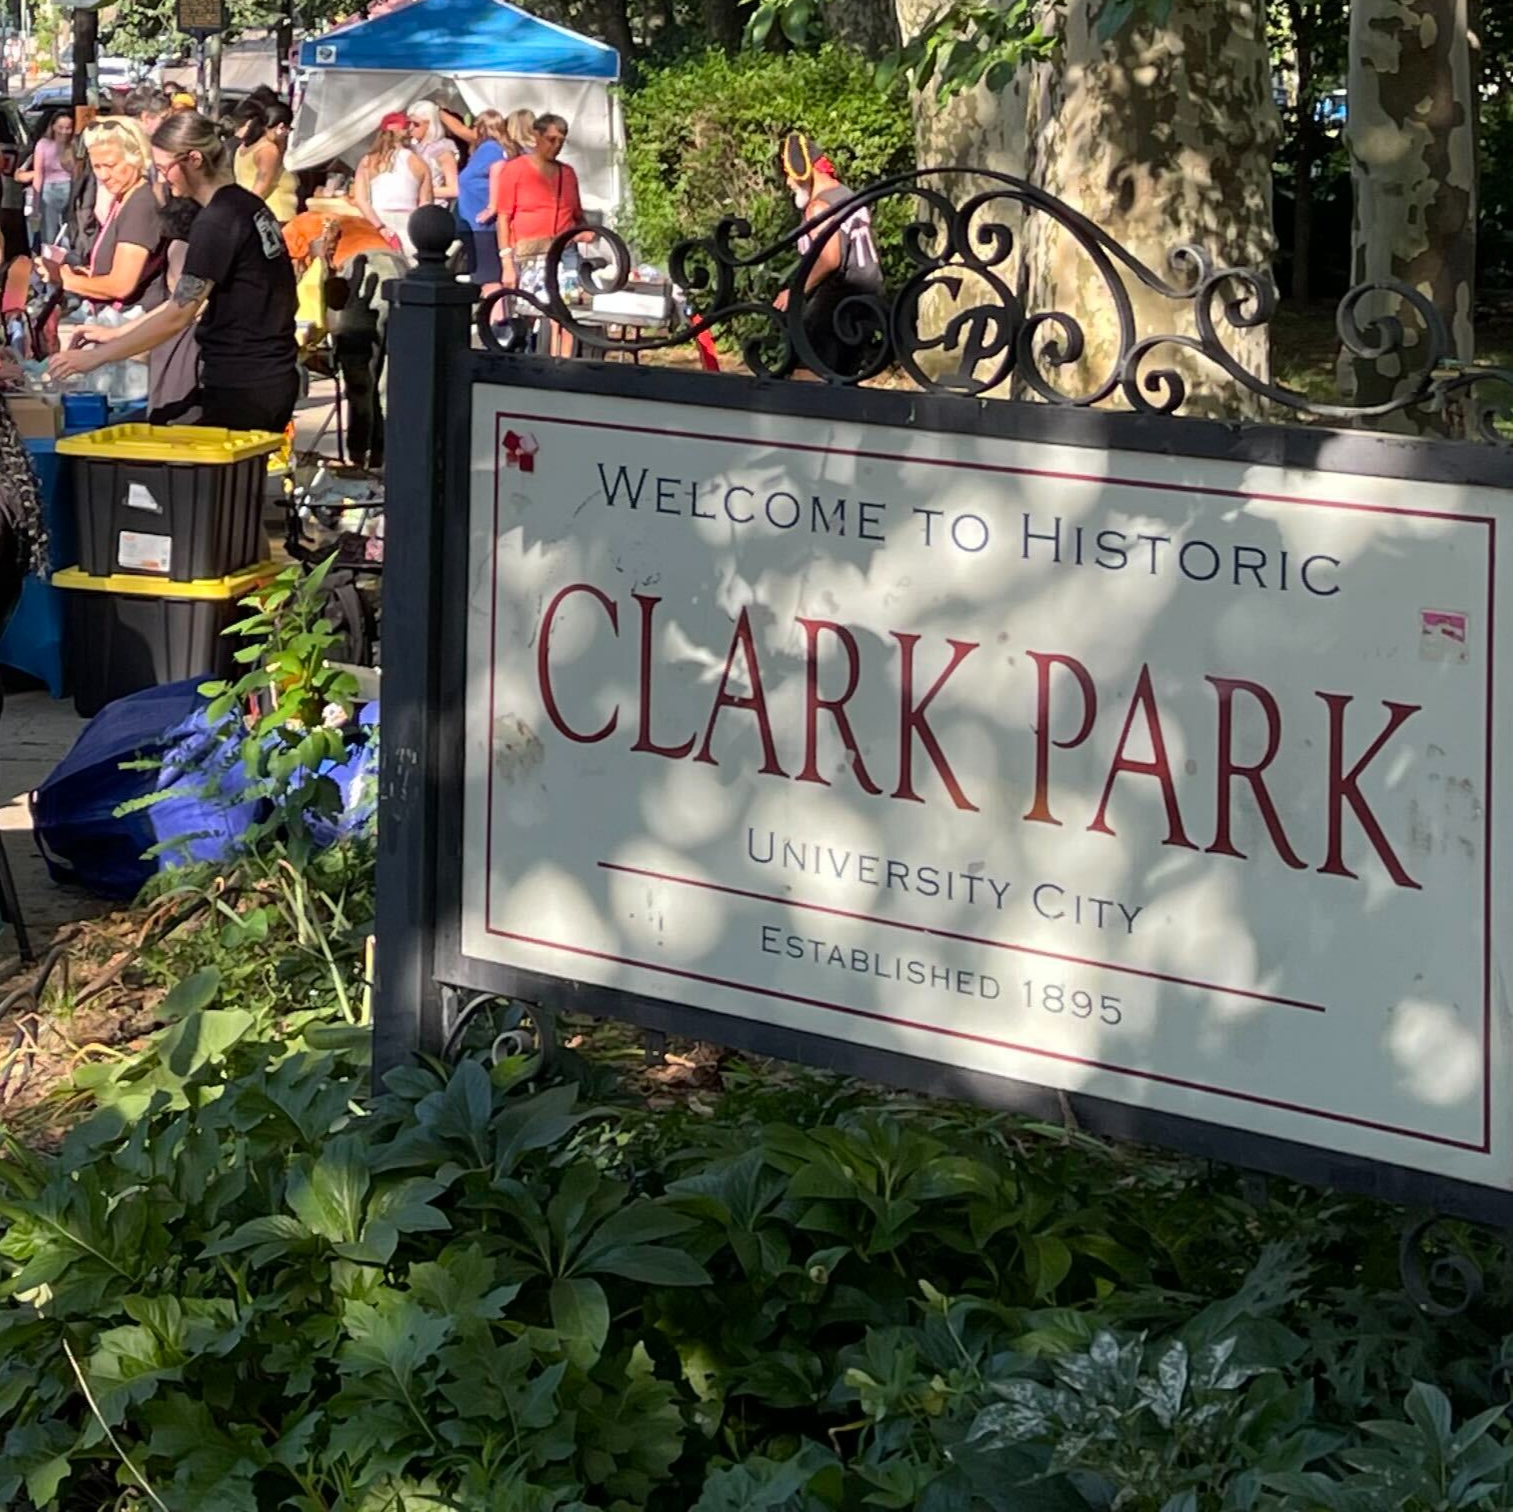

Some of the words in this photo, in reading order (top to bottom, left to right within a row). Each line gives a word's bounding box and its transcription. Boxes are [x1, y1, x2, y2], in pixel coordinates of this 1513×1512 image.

[597, 462, 886, 542] WELCOME
[912, 507, 991, 553] TO
[1022, 513, 1342, 597] HISTORIC
[537, 582, 981, 813] CLARK
[1022, 649, 1423, 891] PARK
[747, 827, 1012, 910] UNIVERSITY
[1032, 883, 1143, 934] CITY
[761, 925, 1000, 1001] ESTABLISHED
[1022, 980, 1124, 1026] 1895
